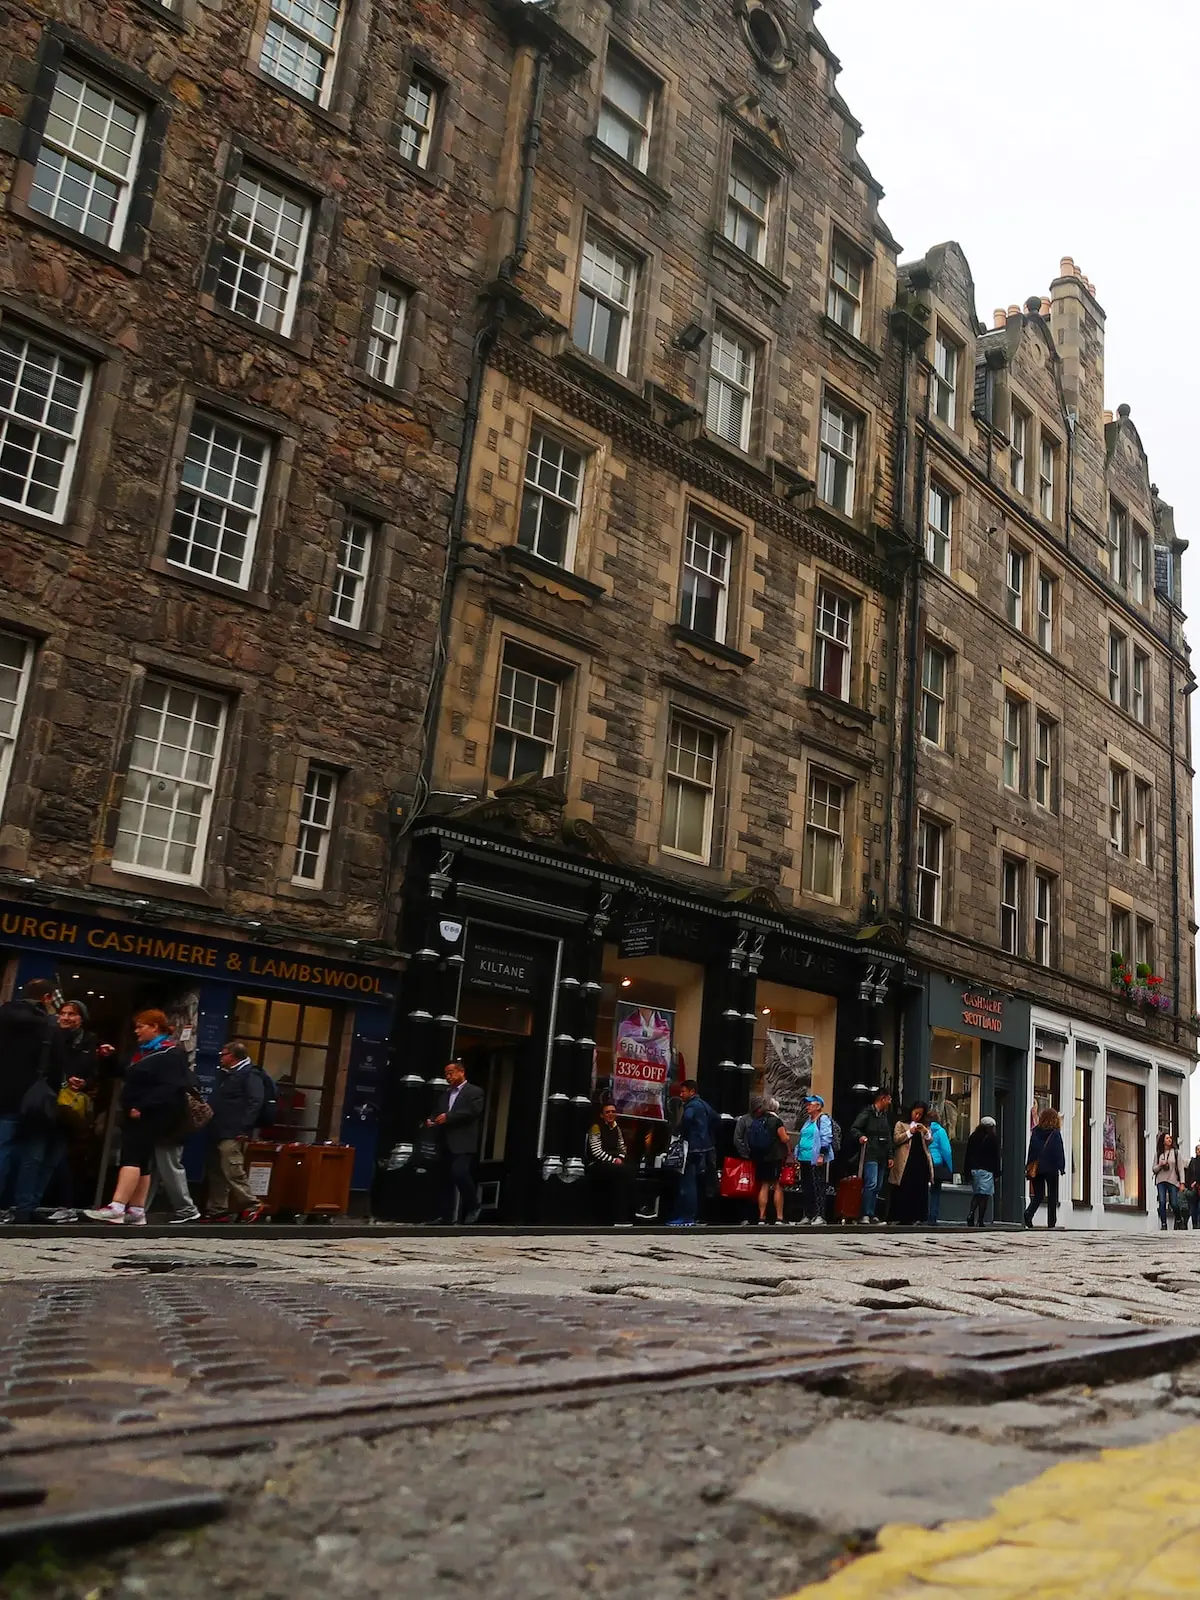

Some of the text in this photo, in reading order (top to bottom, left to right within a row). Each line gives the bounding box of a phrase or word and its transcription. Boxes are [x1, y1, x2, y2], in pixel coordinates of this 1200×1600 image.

[86, 928, 218, 968] CASHMERE
[226, 951, 243, 972] &
[248, 955, 385, 995] LAMBSWOOL
[479, 959, 526, 979] KILTANE
[962, 992, 1003, 1015] CASHMERE
[961, 1010, 1002, 1032] SCOTLAND
[620, 1040, 666, 1058] PRINGLE
[618, 1061, 665, 1080] 33% OFF
